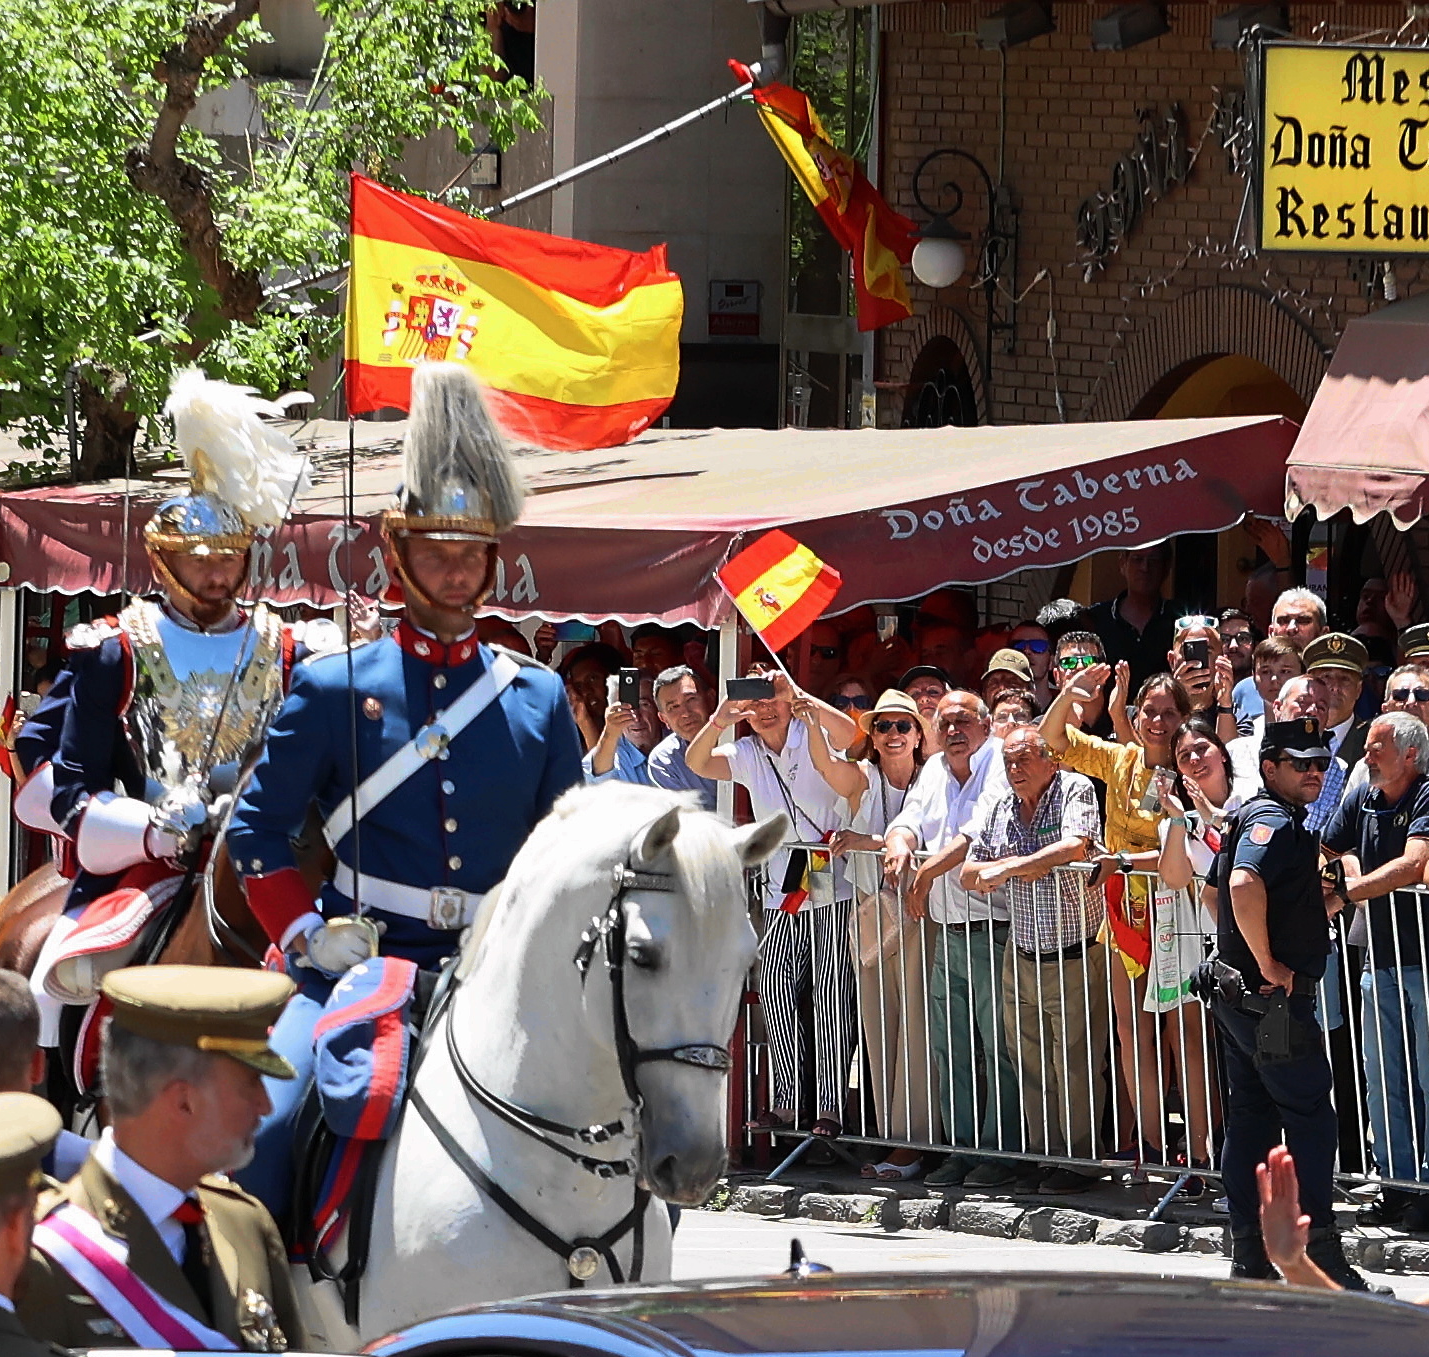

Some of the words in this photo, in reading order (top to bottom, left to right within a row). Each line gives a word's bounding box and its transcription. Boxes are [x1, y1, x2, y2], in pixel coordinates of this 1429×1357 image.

[1271, 113, 1371, 169] Doña
[879, 496, 1002, 540] Doña
[1015, 458, 1198, 513] Taberna
[972, 525, 1061, 563] desde
[1068, 506, 1140, 545] 1985
